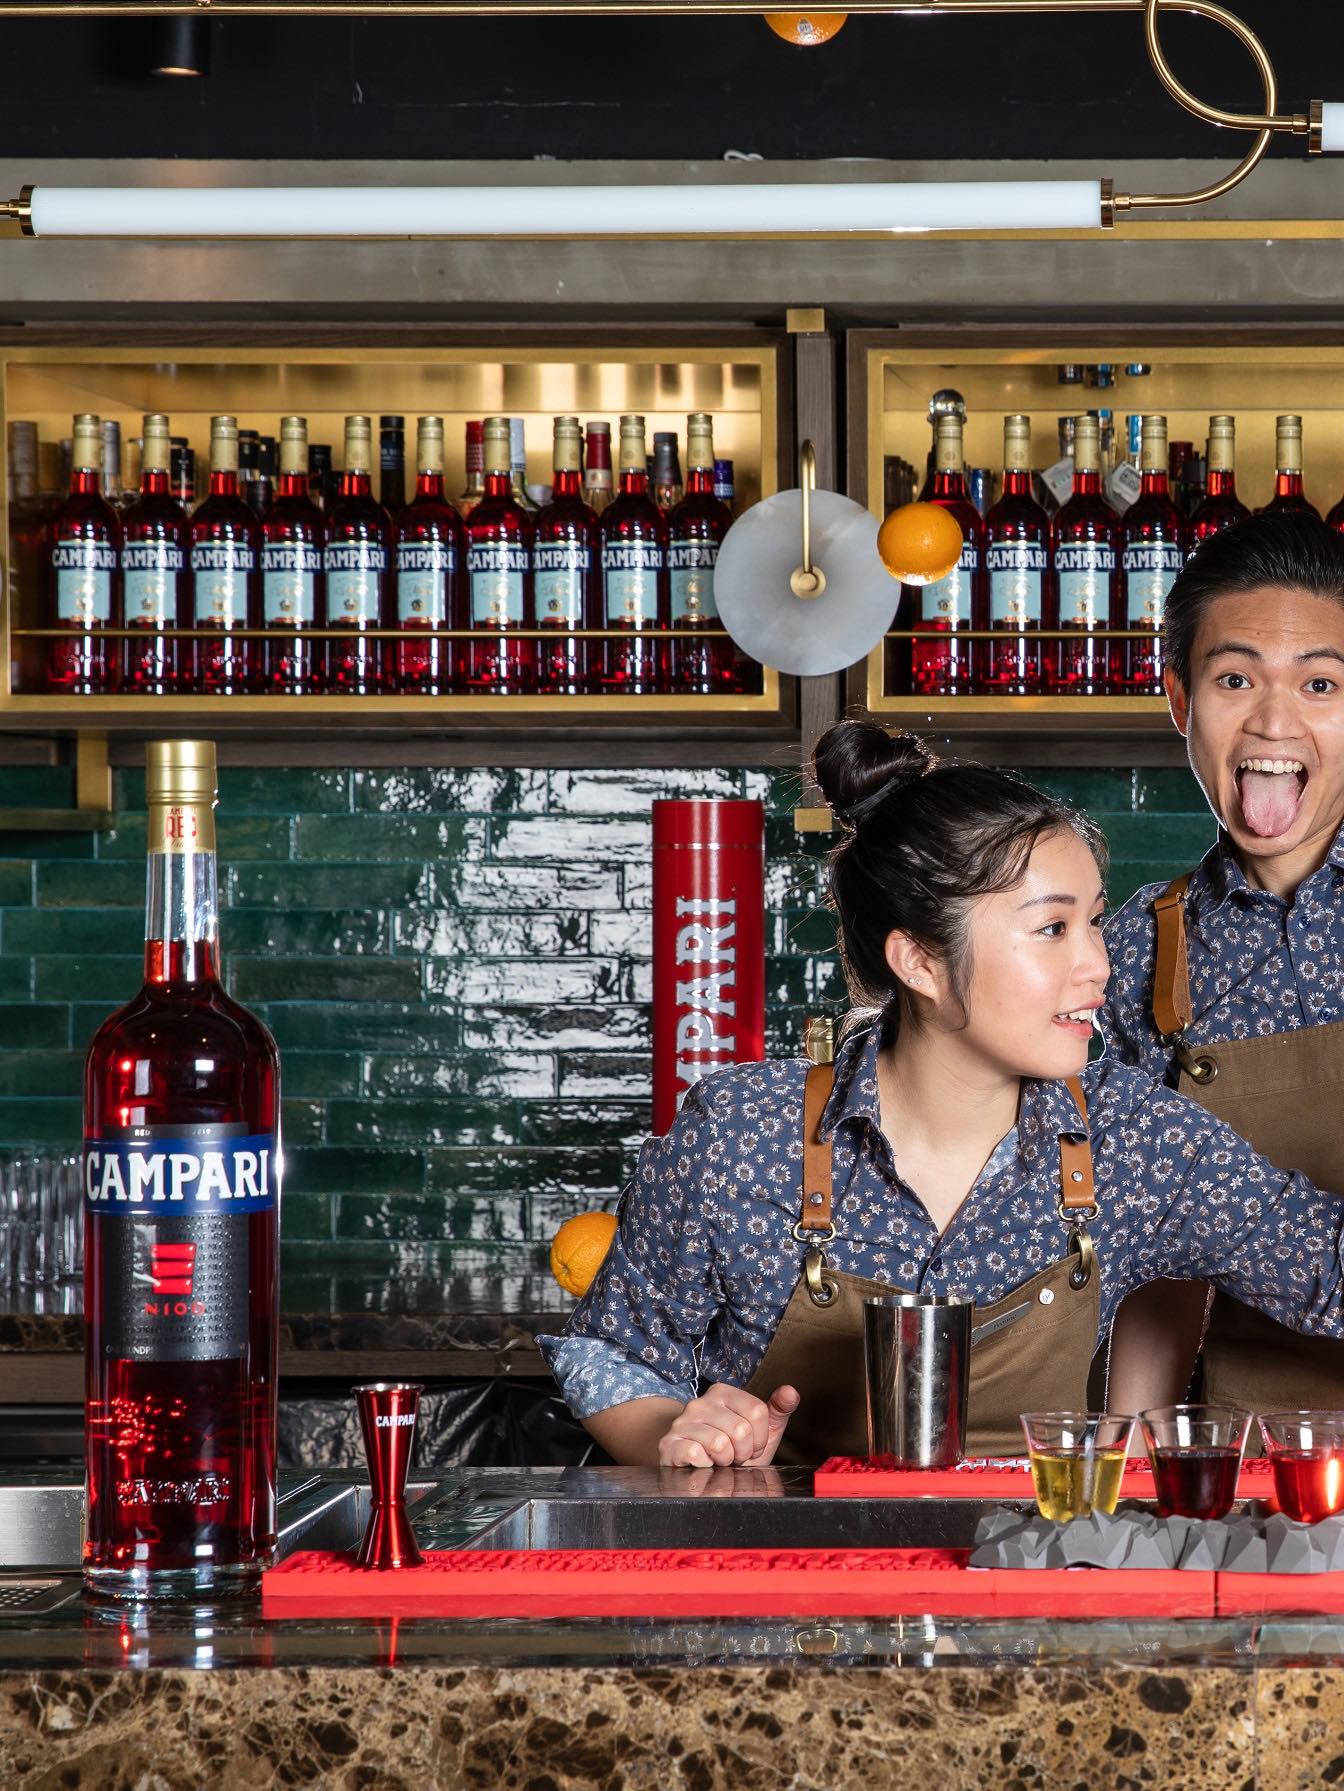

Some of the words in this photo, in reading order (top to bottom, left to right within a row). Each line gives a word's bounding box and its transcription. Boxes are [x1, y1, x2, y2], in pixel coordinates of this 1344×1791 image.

[52, 548, 116, 569] CAMPARI
[121, 549, 183, 569] CAMPARI
[190, 549, 254, 569] CAMPARI
[397, 550, 454, 569] AMPARI
[466, 550, 529, 569] CAMPARI
[532, 550, 590, 569] AMPARI
[986, 550, 1048, 569] CAMPARI
[1054, 550, 1116, 570] CAMPARI
[1122, 550, 1183, 569] CAMPARI
[86, 1150, 269, 1202] CAMPARI
